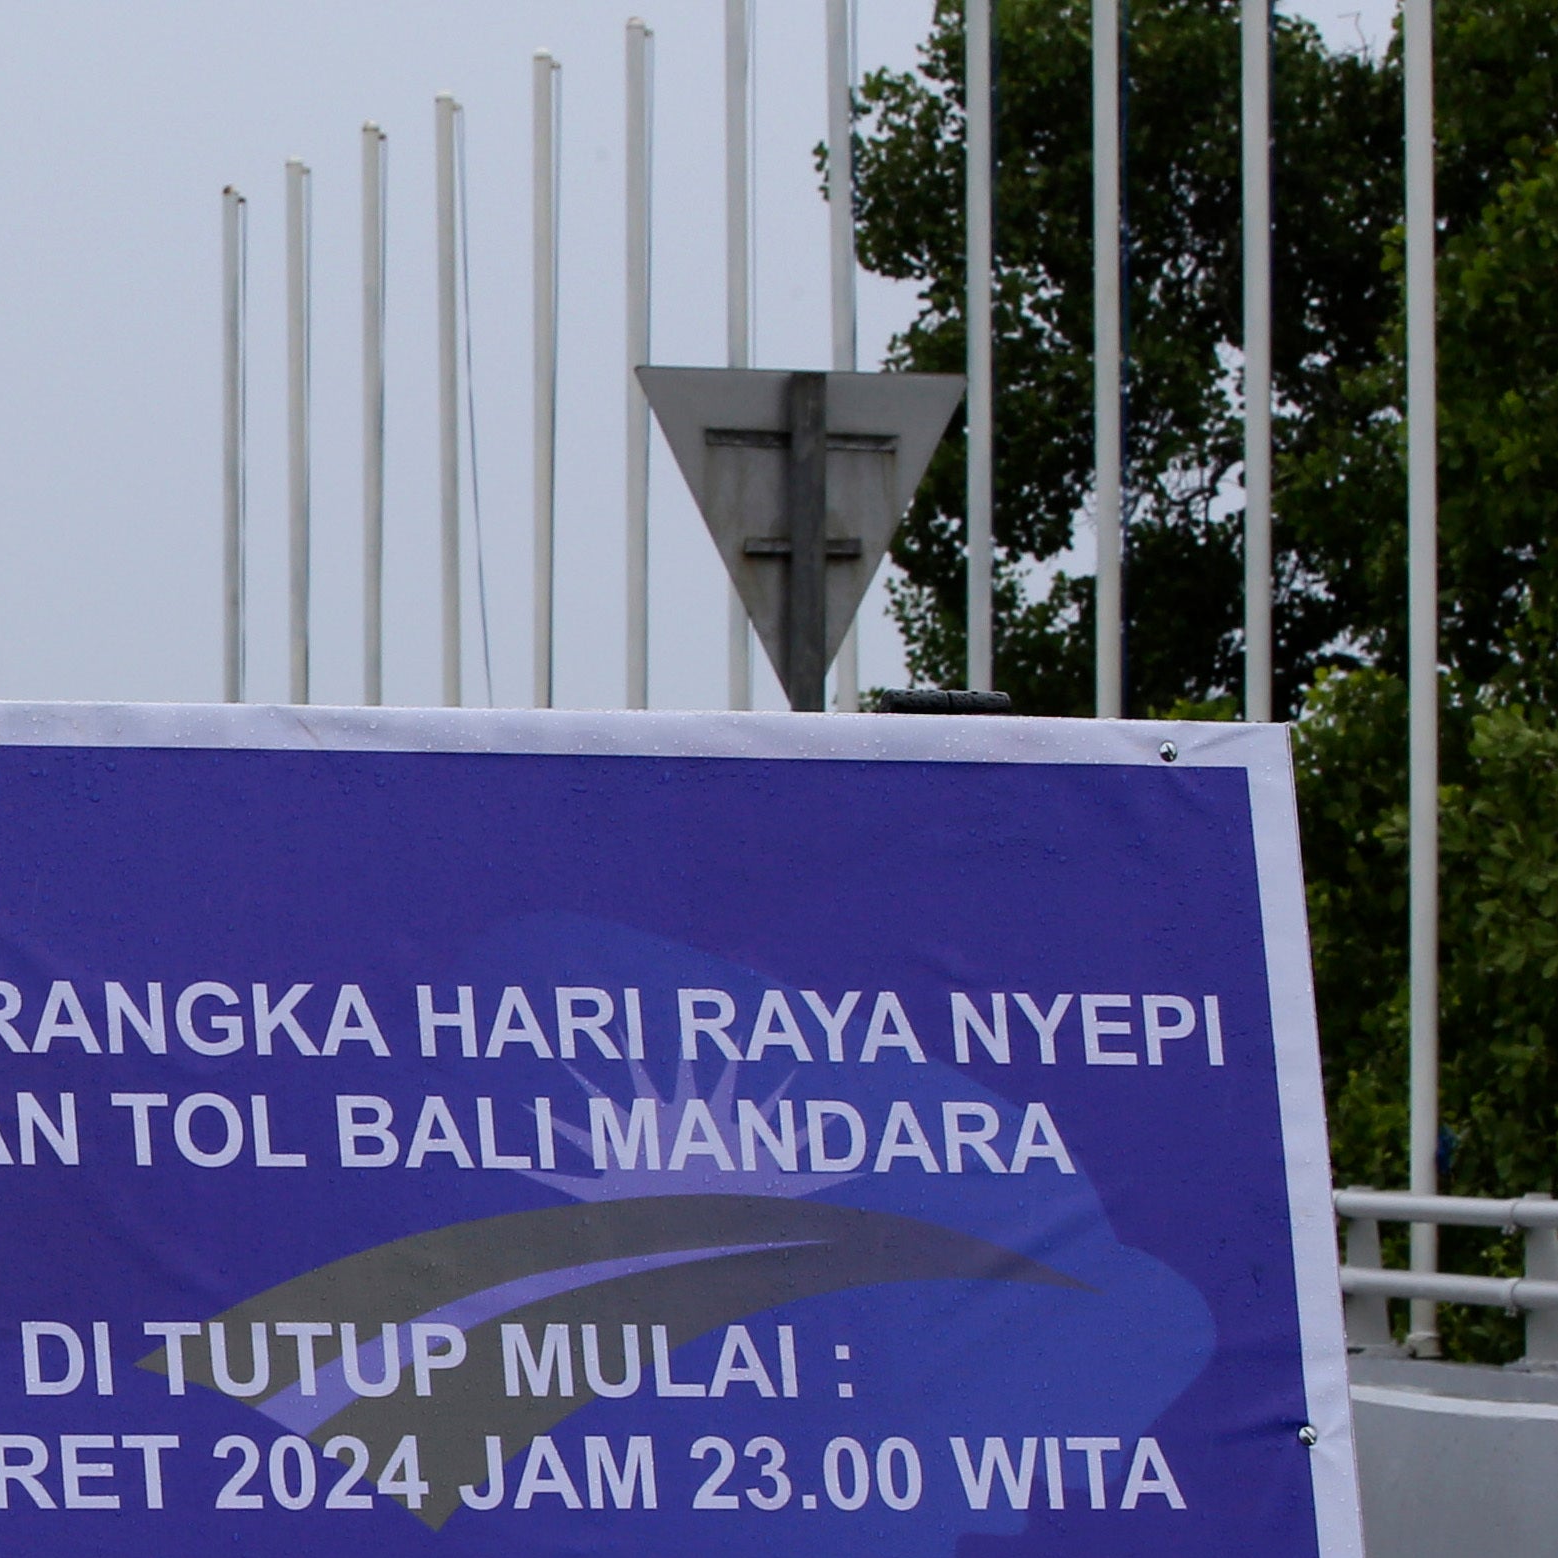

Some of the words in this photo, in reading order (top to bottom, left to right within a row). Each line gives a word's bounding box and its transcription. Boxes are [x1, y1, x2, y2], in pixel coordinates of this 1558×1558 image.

[417, 985, 645, 1060] HARI
[678, 989, 927, 1063] RAYA
[951, 993, 1225, 1066] NYEPI
[111, 1093, 307, 1168] TOL
[337, 1096, 556, 1169] BALI
[589, 1098, 1076, 1174] MANDARA
[22, 1322, 114, 1396] DI
[144, 1322, 467, 1398] TUTUP
[501, 1324, 798, 1398] MULAI
[214, 1435, 430, 1510] 2024
[459, 1435, 658, 1510] JAM
[691, 1436, 923, 1511] 23.00
[950, 1437, 1187, 1511] WITA
